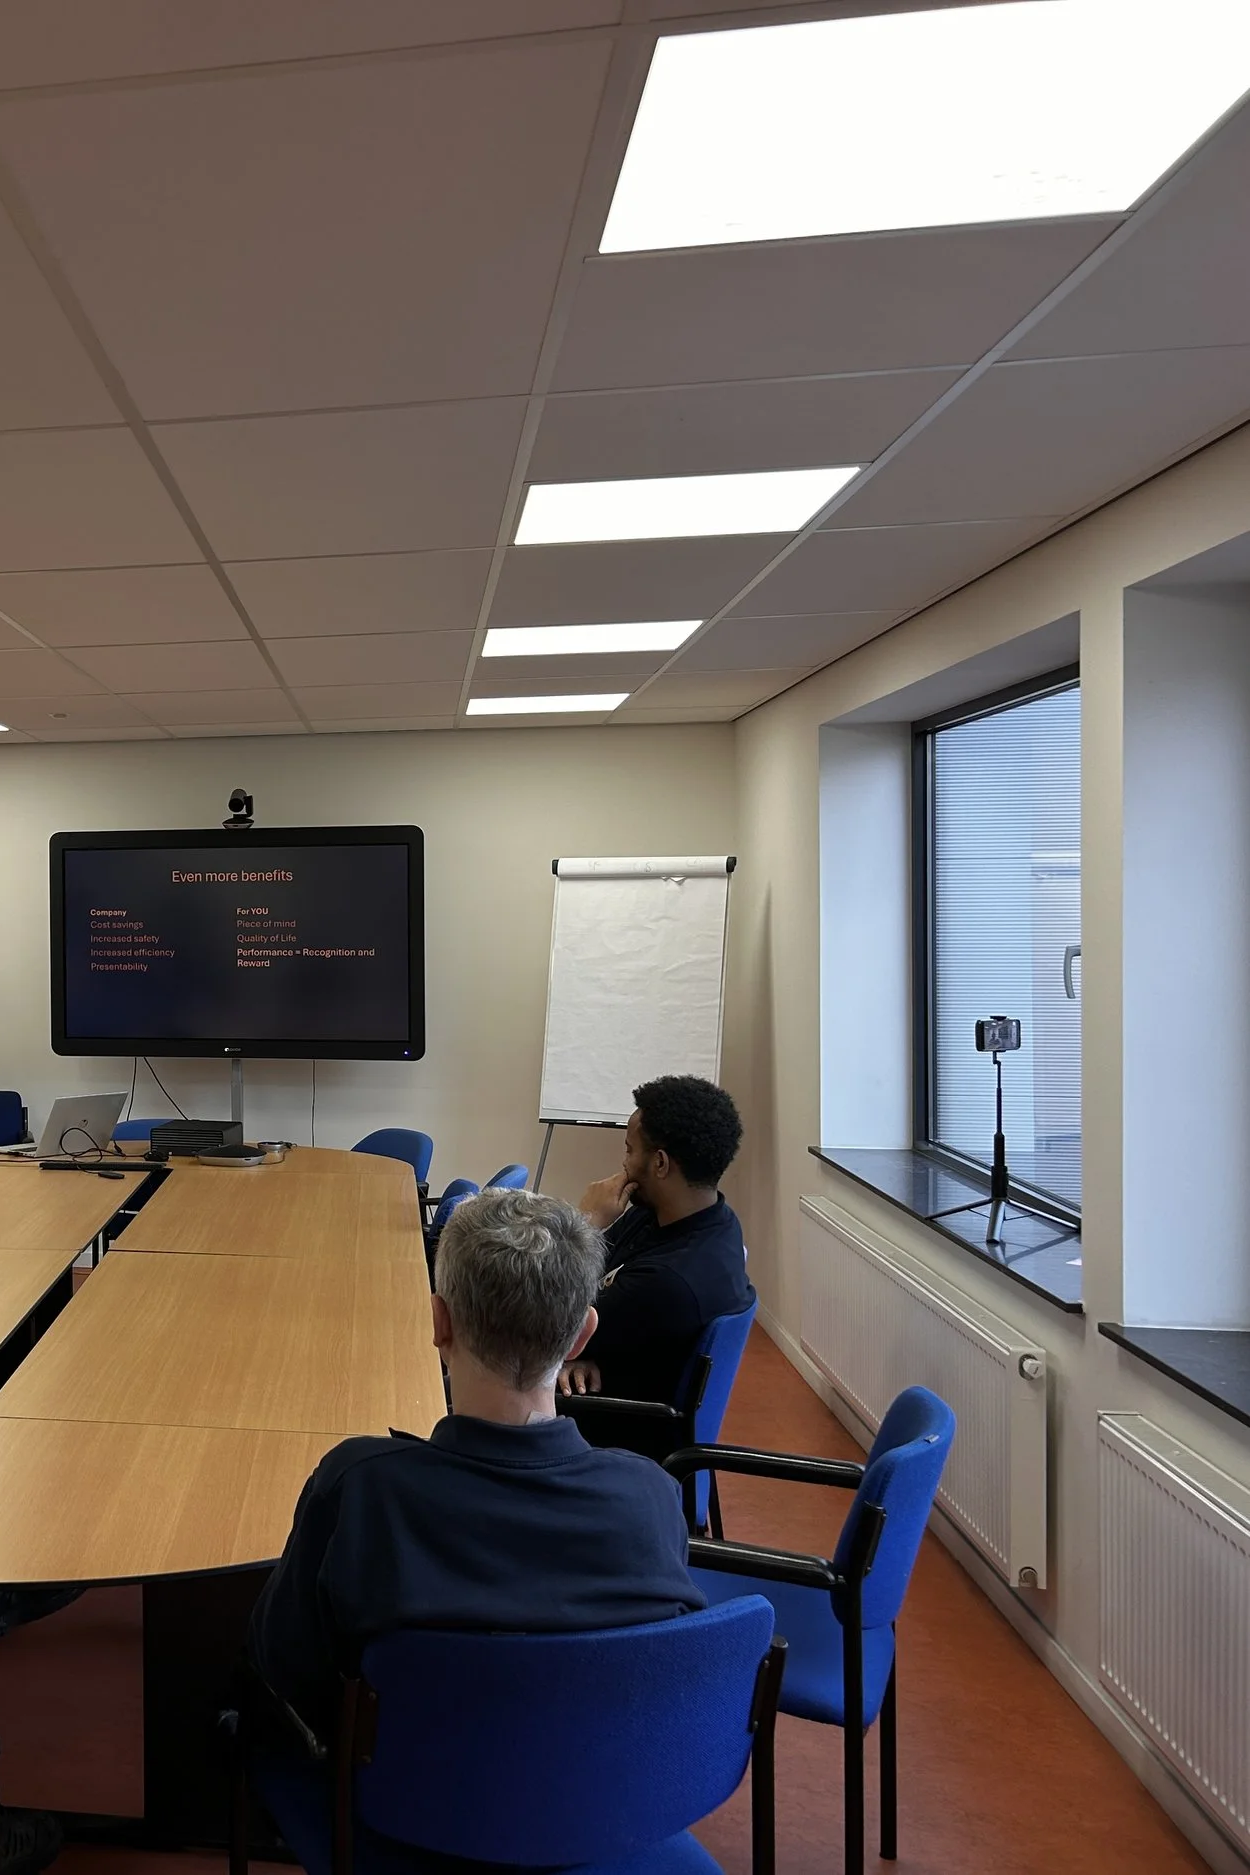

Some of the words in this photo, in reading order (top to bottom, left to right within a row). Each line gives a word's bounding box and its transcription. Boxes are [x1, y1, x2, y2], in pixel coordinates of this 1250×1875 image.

[171, 870, 202, 883] Even
[205, 871, 238, 882] more
[241, 869, 293, 882] benefits
[90, 909, 127, 917] Company
[236, 907, 249, 915] For
[250, 907, 269, 915] YOU
[90, 920, 110, 929] Cost
[112, 920, 144, 930] savings
[236, 920, 261, 928] Piece
[262, 920, 272, 928] of
[273, 920, 296, 928] mind
[90, 935, 132, 943] Increased
[133, 935, 160, 944] safety
[237, 934, 268, 944] Quality
[269, 934, 279, 942] of
[281, 934, 297, 942] Life
[90, 949, 132, 957] Increased
[133, 948, 175, 958] efficiency
[237, 948, 294, 956] Performance
[302, 948, 356, 958] Recognition
[357, 948, 375, 956] and
[91, 962, 148, 972] Presentability
[237, 959, 270, 967] Reward
